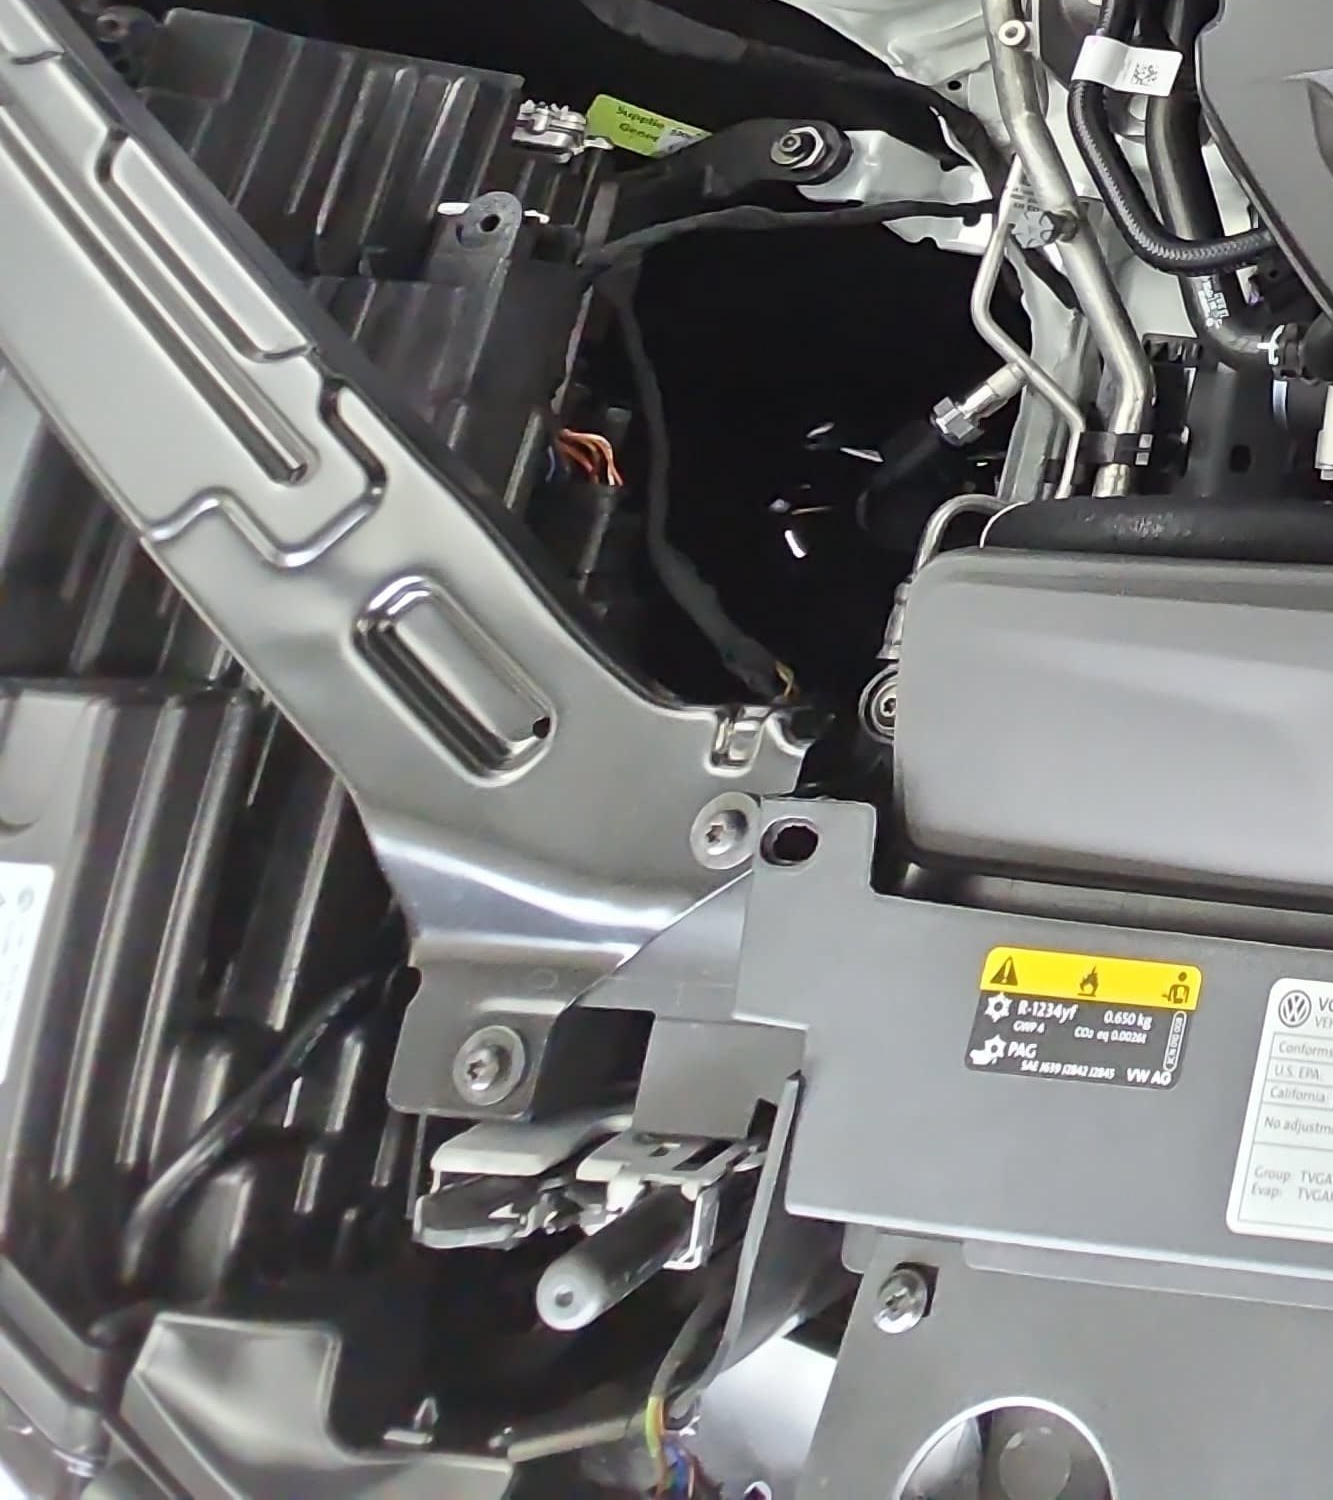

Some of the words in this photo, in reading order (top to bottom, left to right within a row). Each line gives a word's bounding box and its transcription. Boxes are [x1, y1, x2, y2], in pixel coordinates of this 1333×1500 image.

[1016, 999, 1078, 1024] R-1234yf
[1102, 1010, 1136, 1026] 0.650
[1136, 1013, 1153, 1030] kg
[1007, 1041, 1037, 1058] PAG
[1277, 1040, 1333, 1057] Conforms
[1125, 1068, 1150, 1083] VW
[1151, 1070, 1172, 1085] AG
[1263, 1115, 1281, 1130] No
